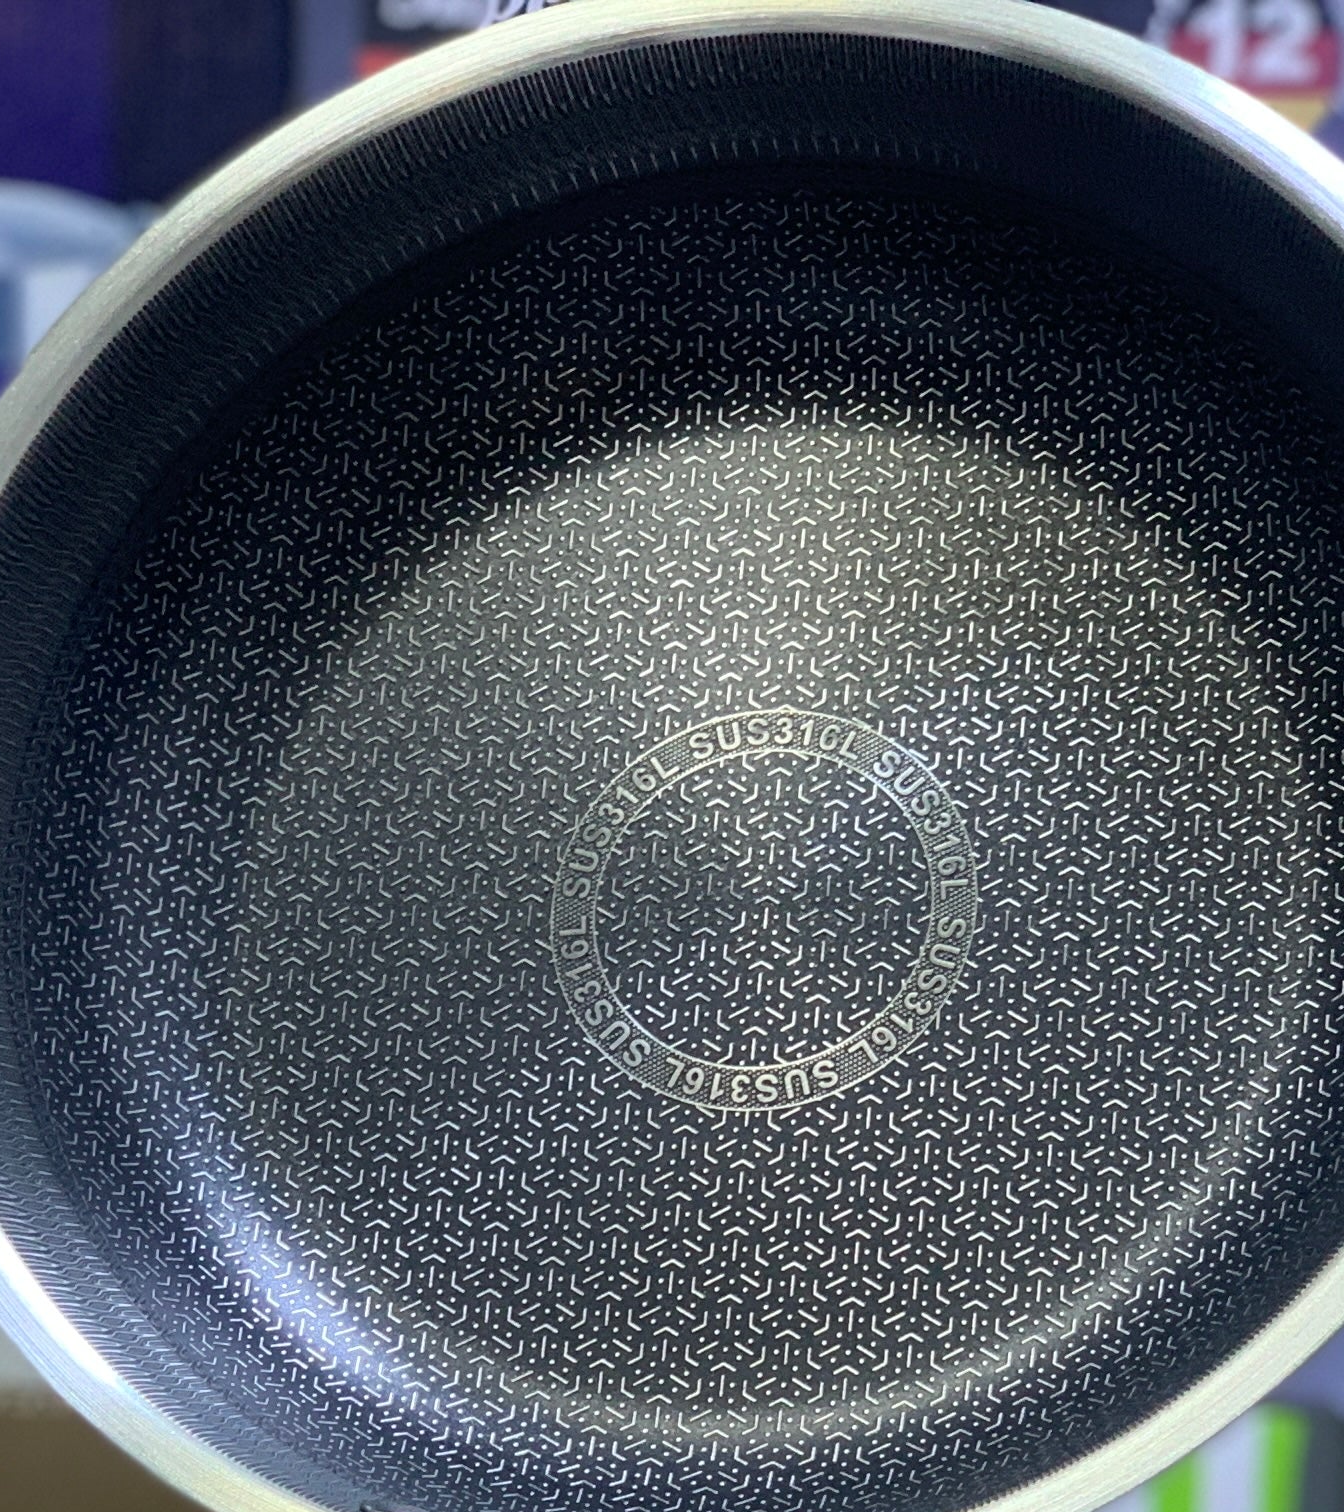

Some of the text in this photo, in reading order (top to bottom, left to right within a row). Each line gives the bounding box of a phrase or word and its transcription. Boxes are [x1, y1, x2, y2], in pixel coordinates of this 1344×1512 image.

[687, 715, 860, 764] SUS316L
[561, 754, 681, 902] SUS316L
[871, 746, 971, 904] SUS316L
[558, 913, 653, 1069] SUS316L
[846, 914, 968, 1070] SUS316L
[664, 1056, 840, 1105] SUS316L
